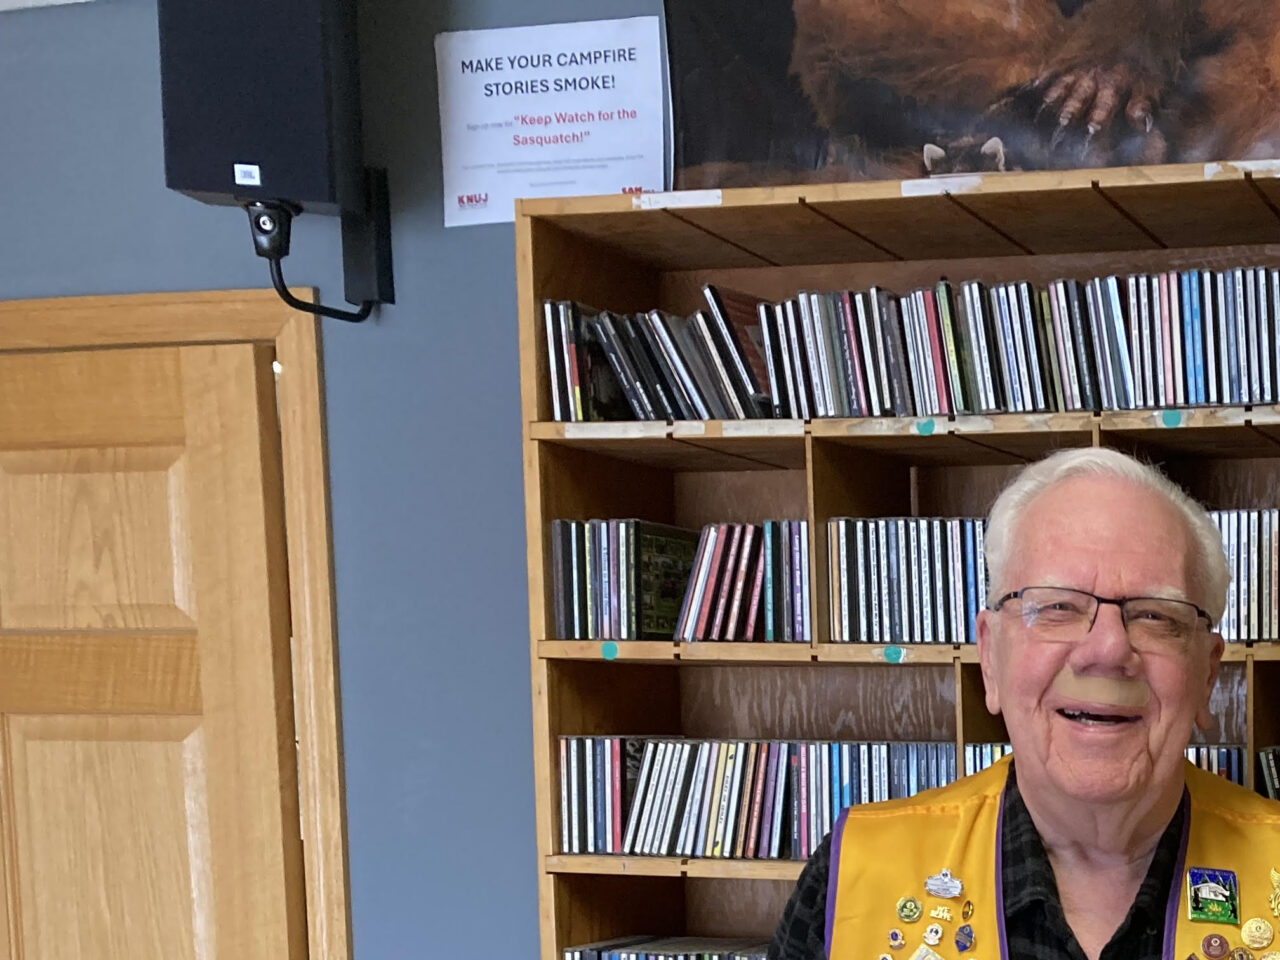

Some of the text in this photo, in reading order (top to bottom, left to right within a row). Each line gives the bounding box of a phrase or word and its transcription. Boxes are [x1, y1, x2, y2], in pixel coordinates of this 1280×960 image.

[461, 47, 637, 74] MAKE YOUR CAMPFIRE
[484, 75, 616, 97] STORIES SMOKE!
[554, 111, 595, 124] Watch
[597, 109, 614, 121] for
[617, 108, 637, 119] the
[457, 193, 489, 206] KNUJ
